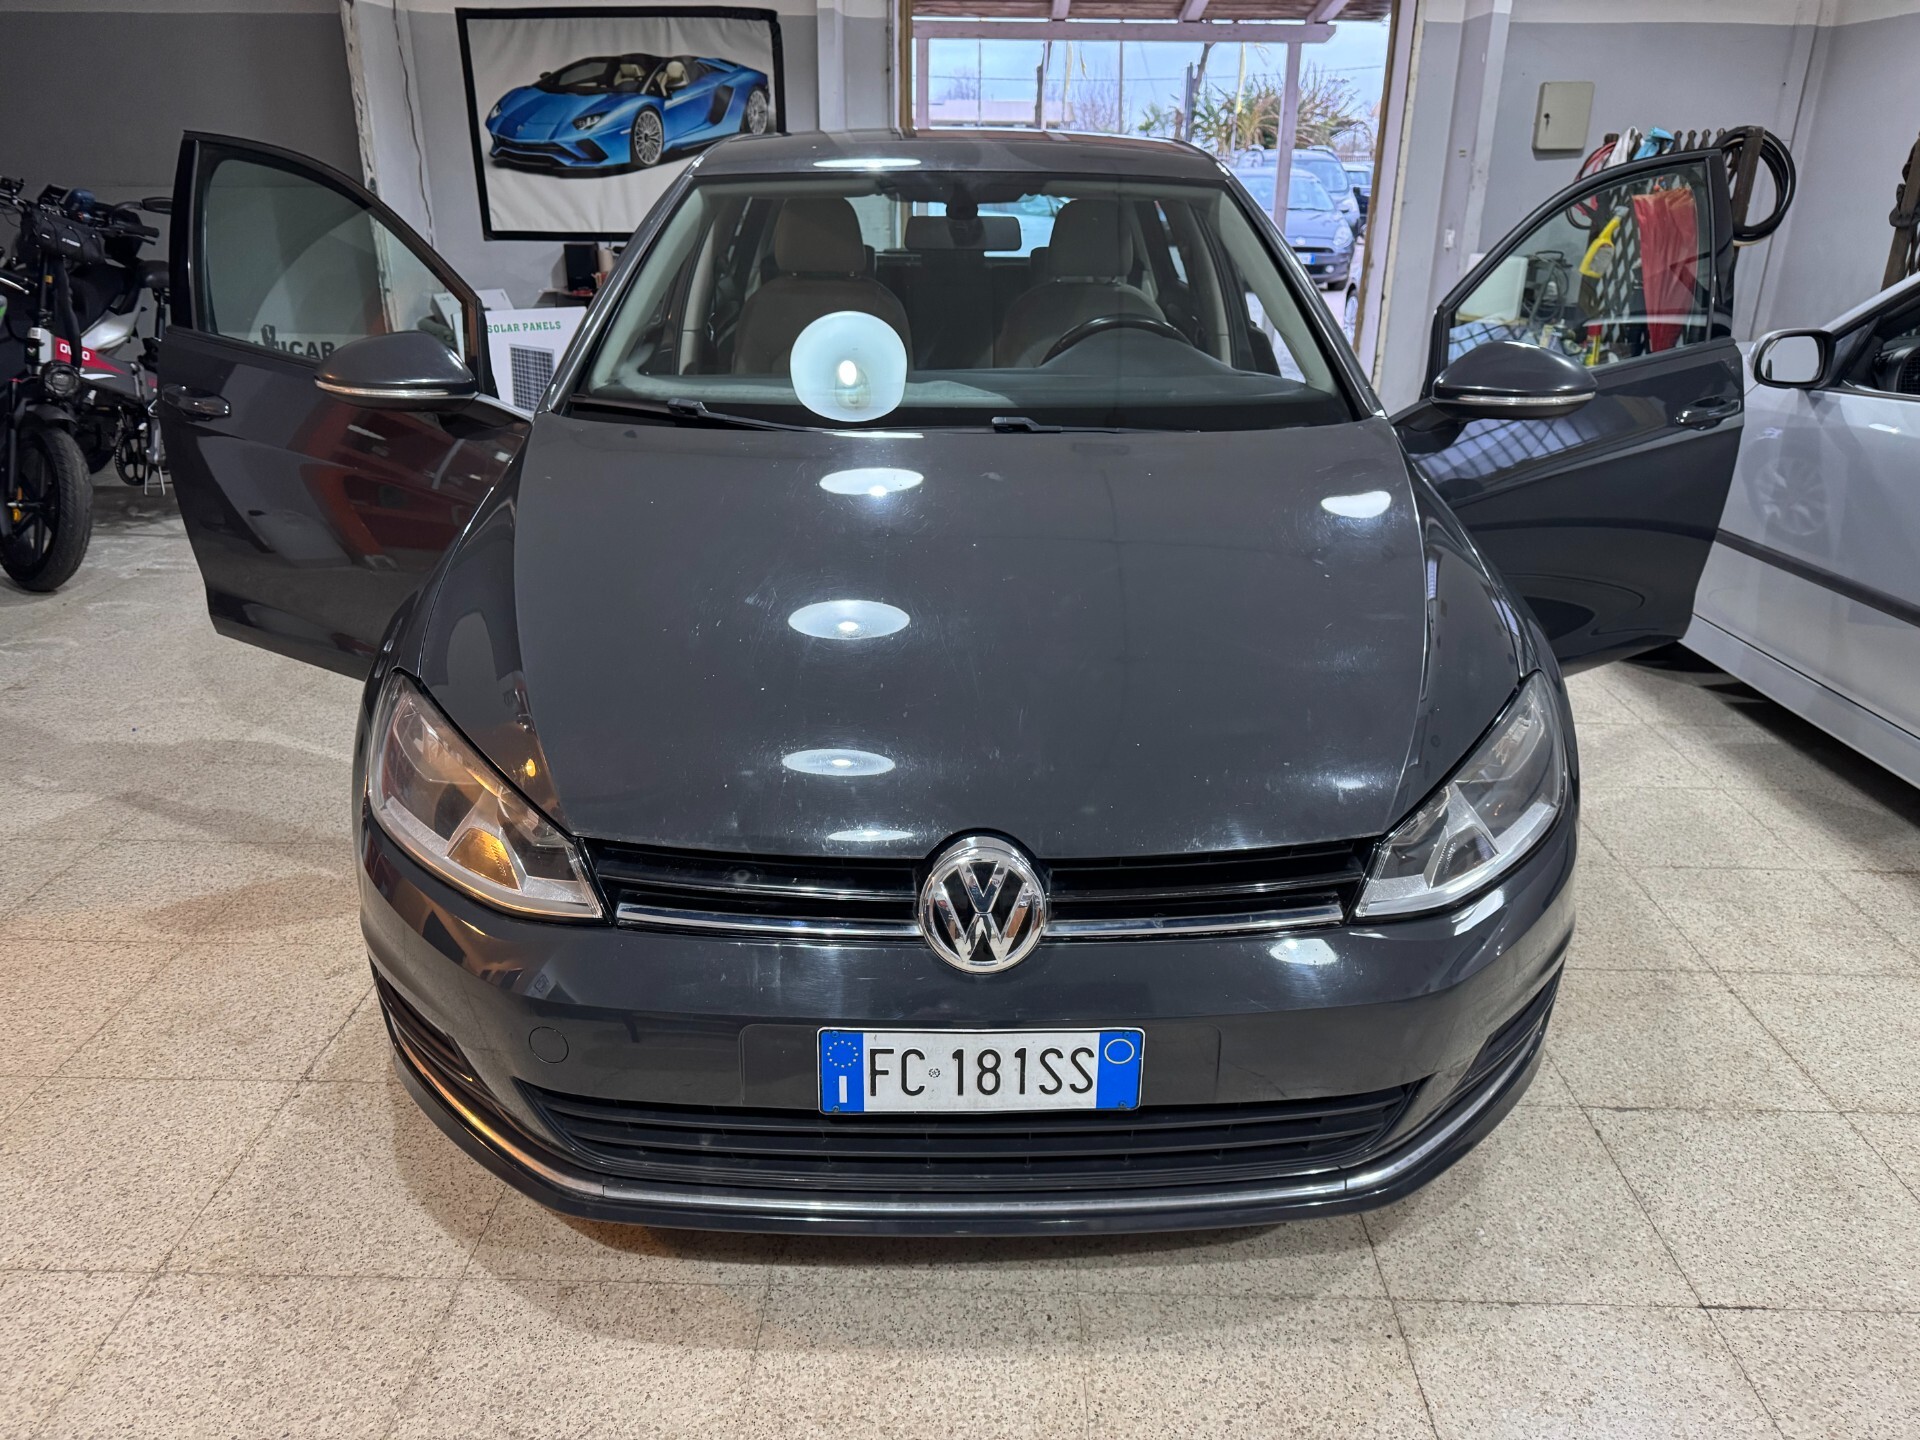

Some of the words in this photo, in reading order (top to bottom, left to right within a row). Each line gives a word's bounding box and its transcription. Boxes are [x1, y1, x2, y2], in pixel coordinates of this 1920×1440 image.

[487, 323, 520, 334] SOLAR
[522, 321, 562, 332] PANELS
[252, 340, 335, 359] ICAR
[929, 857, 1038, 964] VW
[868, 1047, 926, 1097] FC
[951, 1046, 1096, 1097] 181SS
